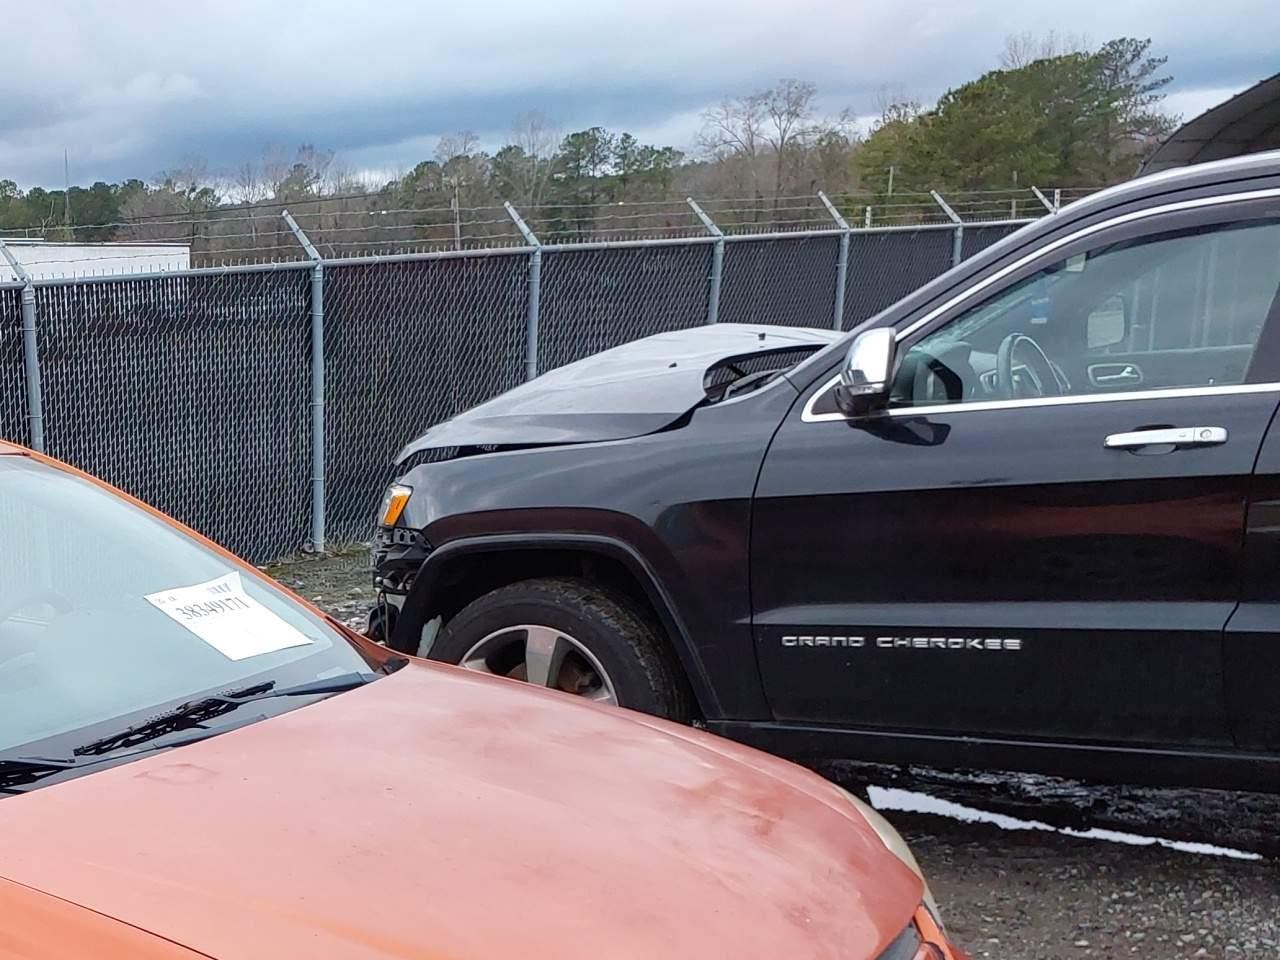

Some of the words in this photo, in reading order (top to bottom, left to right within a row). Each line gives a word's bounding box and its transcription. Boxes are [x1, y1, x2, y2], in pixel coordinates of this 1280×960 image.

[175, 596, 251, 620] 38349171
[781, 636, 865, 648] GRAND
[876, 637, 1023, 650] CHEROKEE
